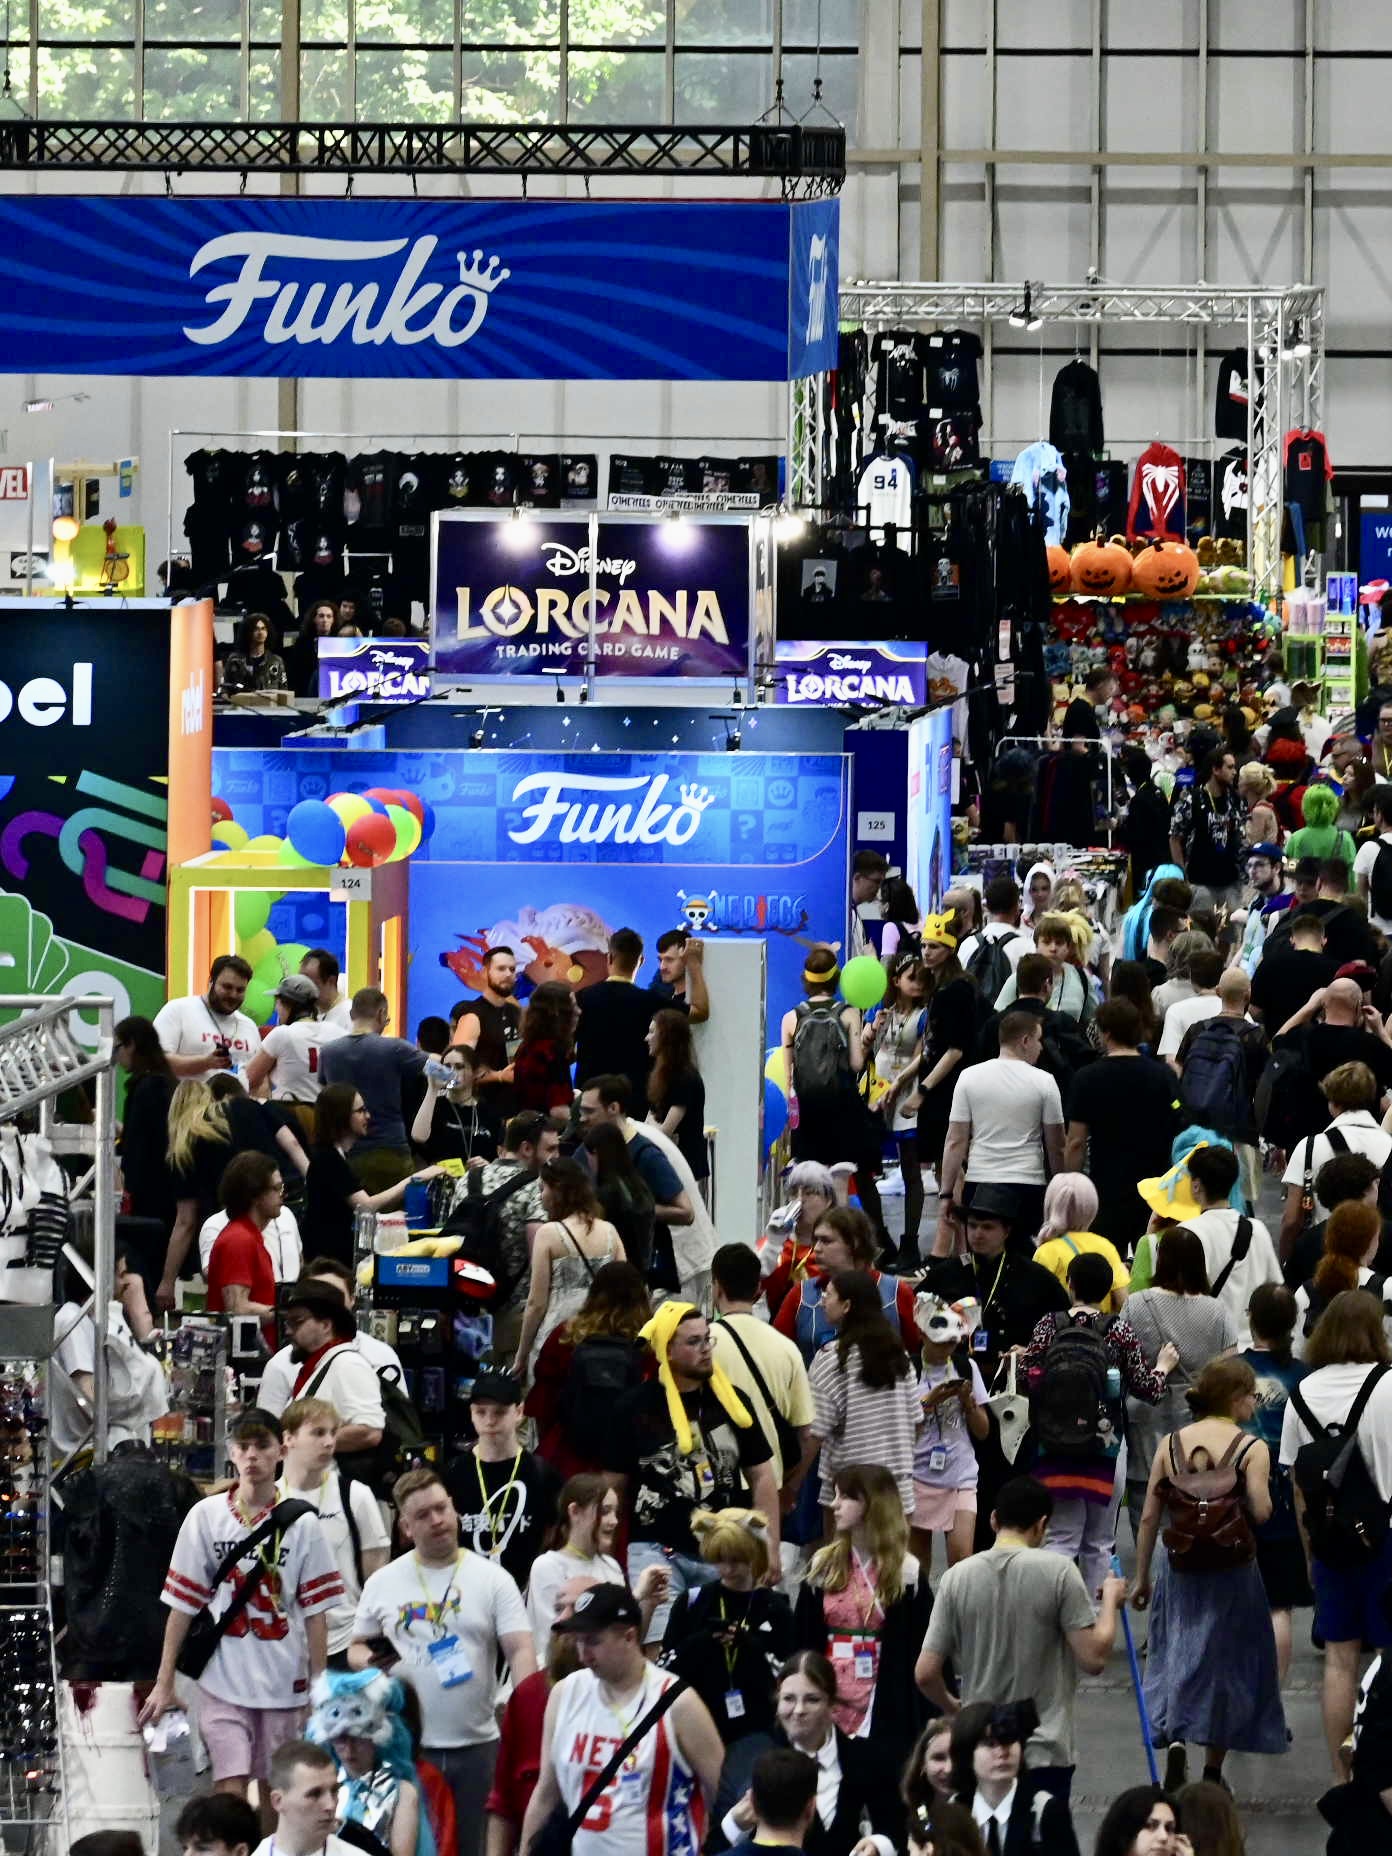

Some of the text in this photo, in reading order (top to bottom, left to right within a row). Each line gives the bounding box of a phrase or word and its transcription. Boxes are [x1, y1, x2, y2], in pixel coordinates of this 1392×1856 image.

[183, 231, 510, 347] Funko
[874, 475, 898, 490] 94
[540, 542, 636, 585] Disney
[456, 584, 730, 645] LORCANA
[496, 643, 572, 659] TRADING
[631, 644, 681, 661] GAME
[827, 653, 872, 674] Disney
[328, 670, 430, 698] LORCAN
[786, 673, 916, 704] LORCANA
[508, 771, 716, 846] Funko
[868, 820, 886, 831] 125
[341, 878, 361, 890] 124
[569, 1733, 641, 1768] NET
